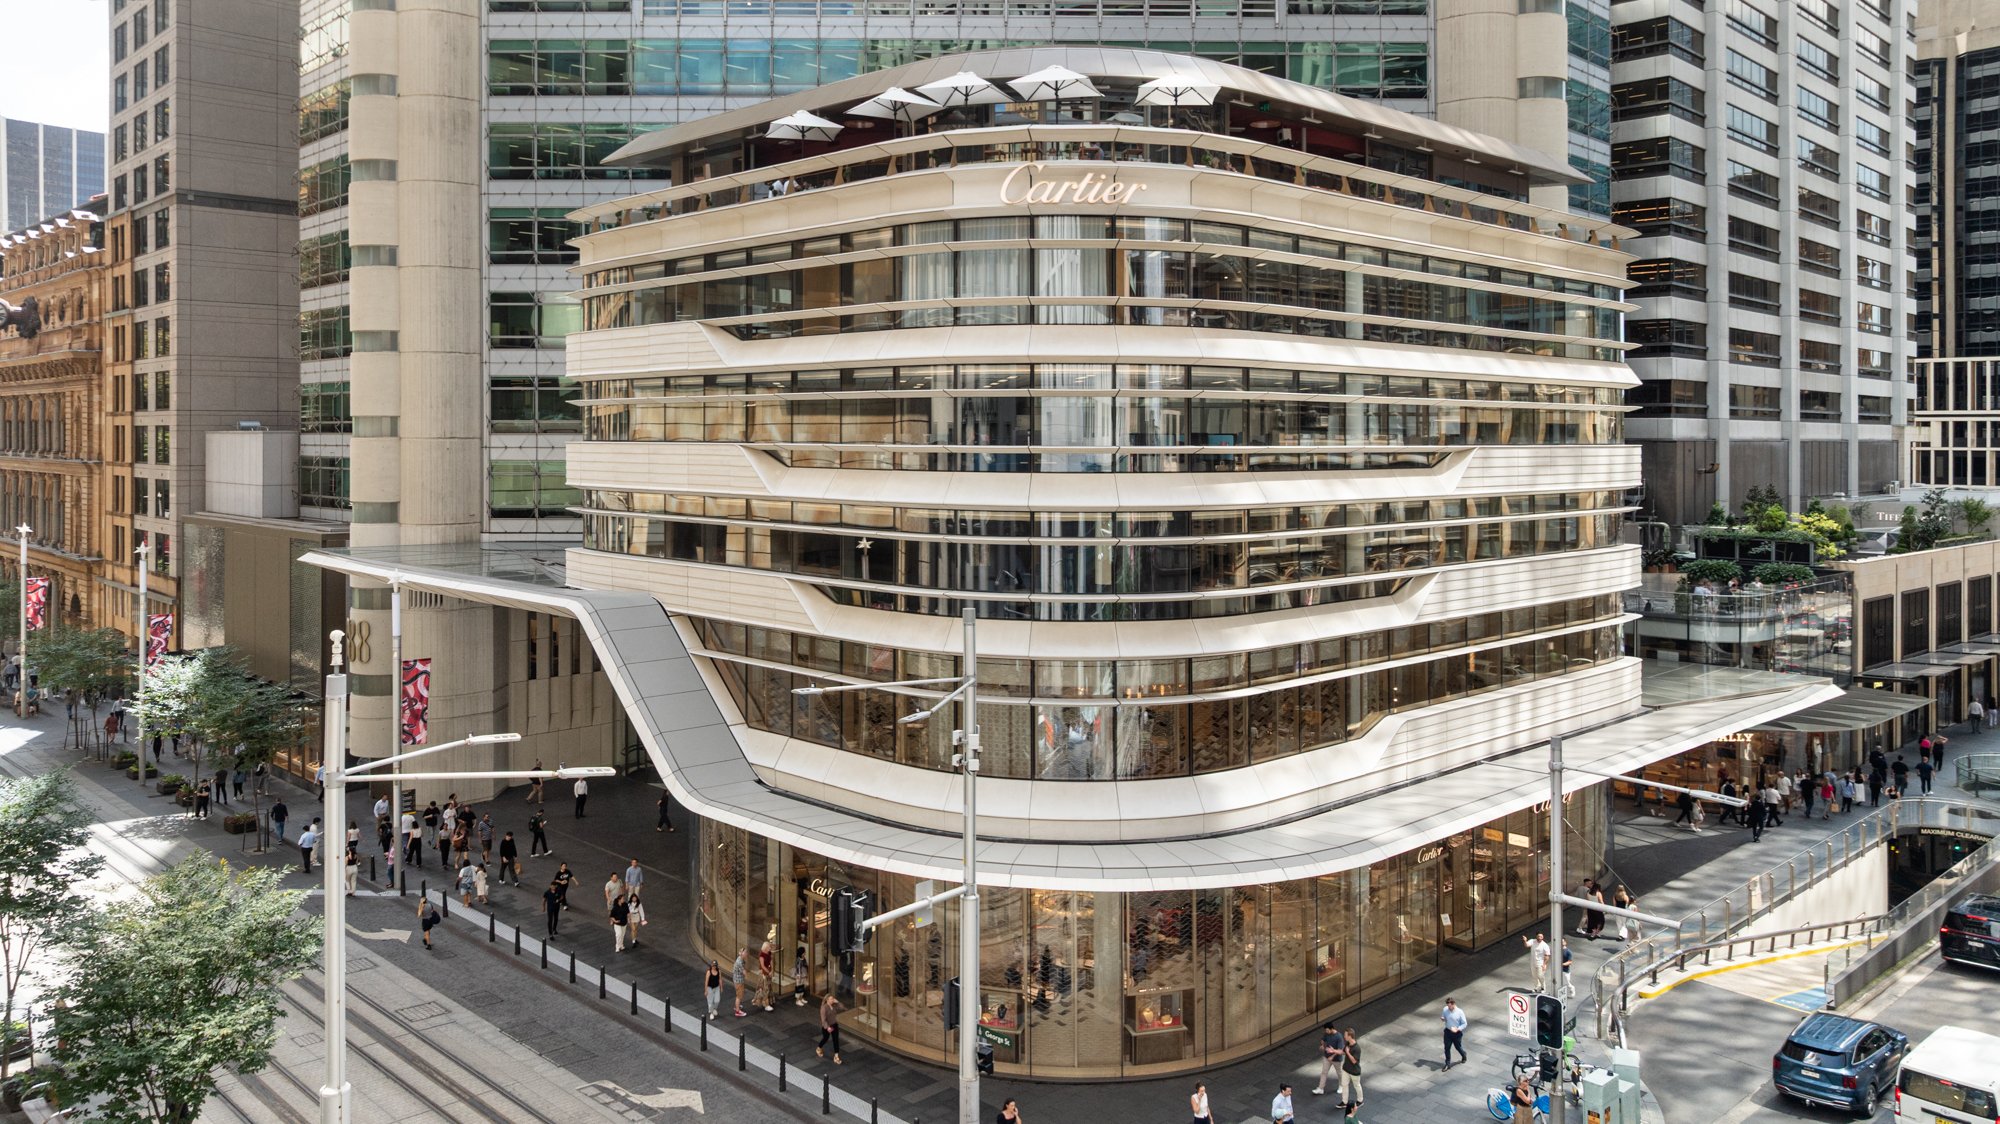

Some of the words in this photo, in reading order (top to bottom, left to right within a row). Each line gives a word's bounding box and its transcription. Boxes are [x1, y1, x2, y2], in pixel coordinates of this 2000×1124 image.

[1000, 163, 1147, 204] Cartier
[1713, 733, 1754, 742] ALLY
[1921, 828, 1955, 837] MAXIMUM
[1417, 846, 1443, 864] Cartier
[1513, 1014, 1525, 1023] NO
[1512, 1022, 1526, 1030] LEFT
[1512, 1028, 1528, 1036] TURN
[984, 1030, 1004, 1044] George
